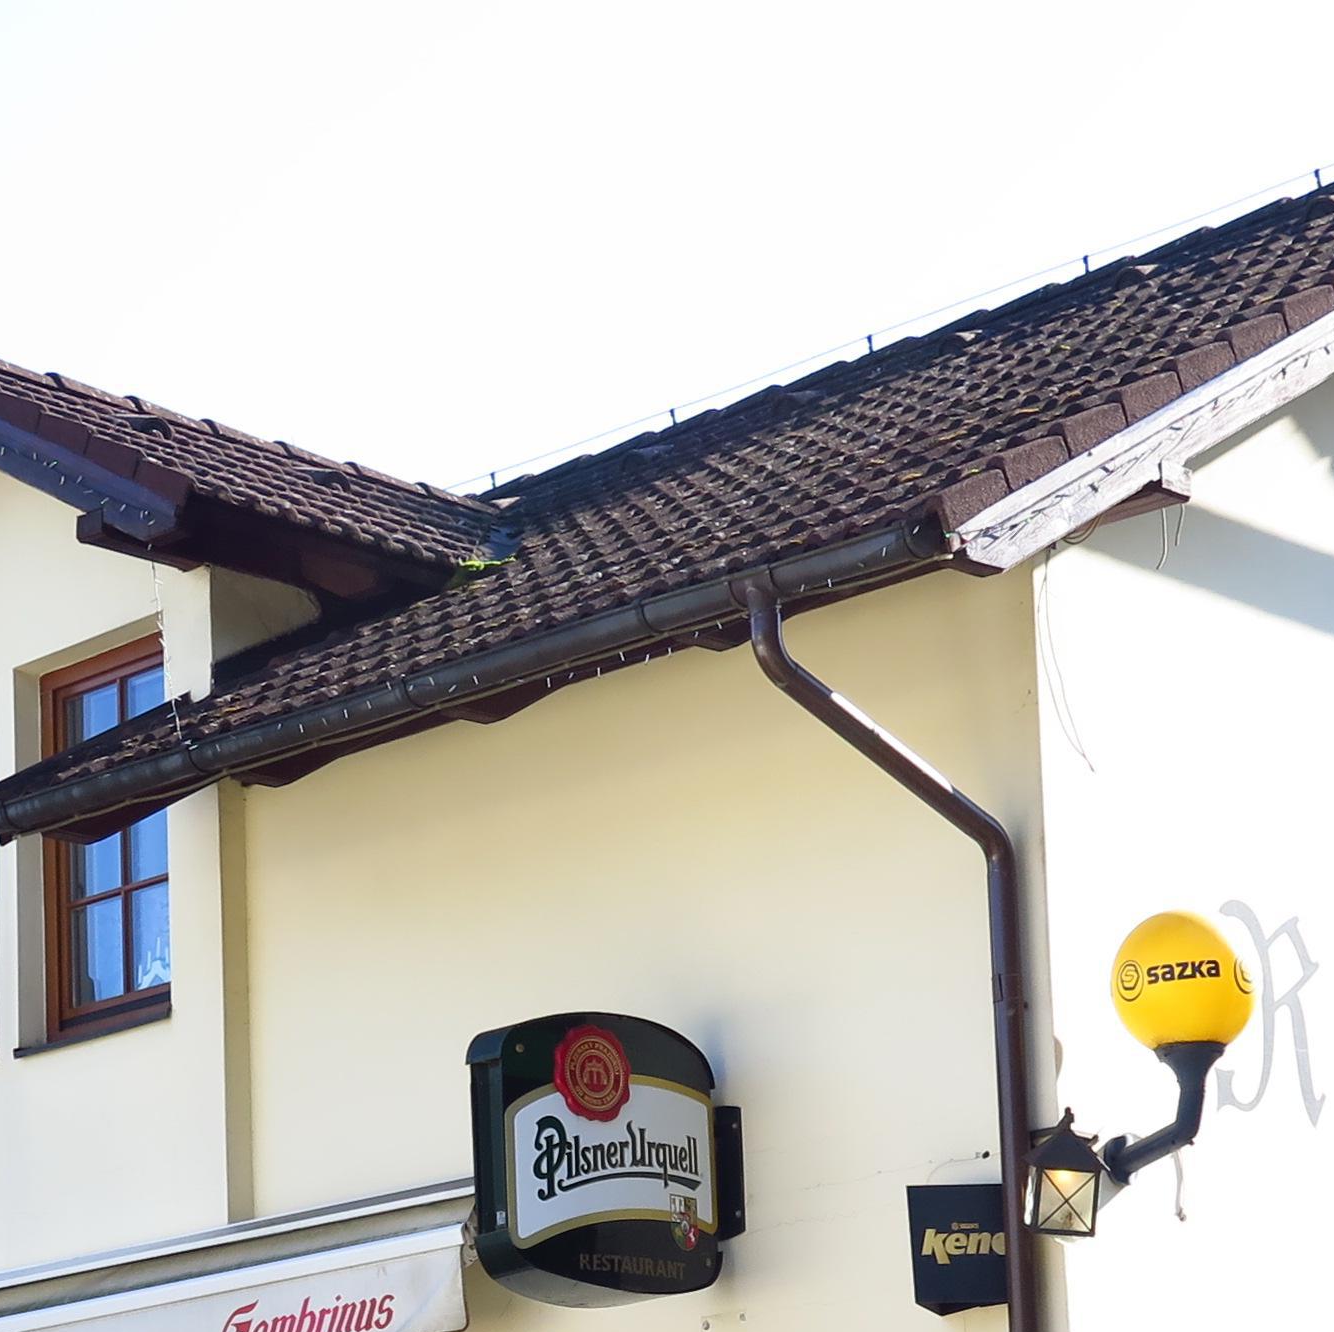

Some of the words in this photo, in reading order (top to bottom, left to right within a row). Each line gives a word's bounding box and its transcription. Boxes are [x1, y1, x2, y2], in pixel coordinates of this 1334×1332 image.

[533, 1115, 630, 1201] Pilsner
[626, 1120, 699, 1187] Urquell
[579, 1253, 686, 1280] RESTAURANT
